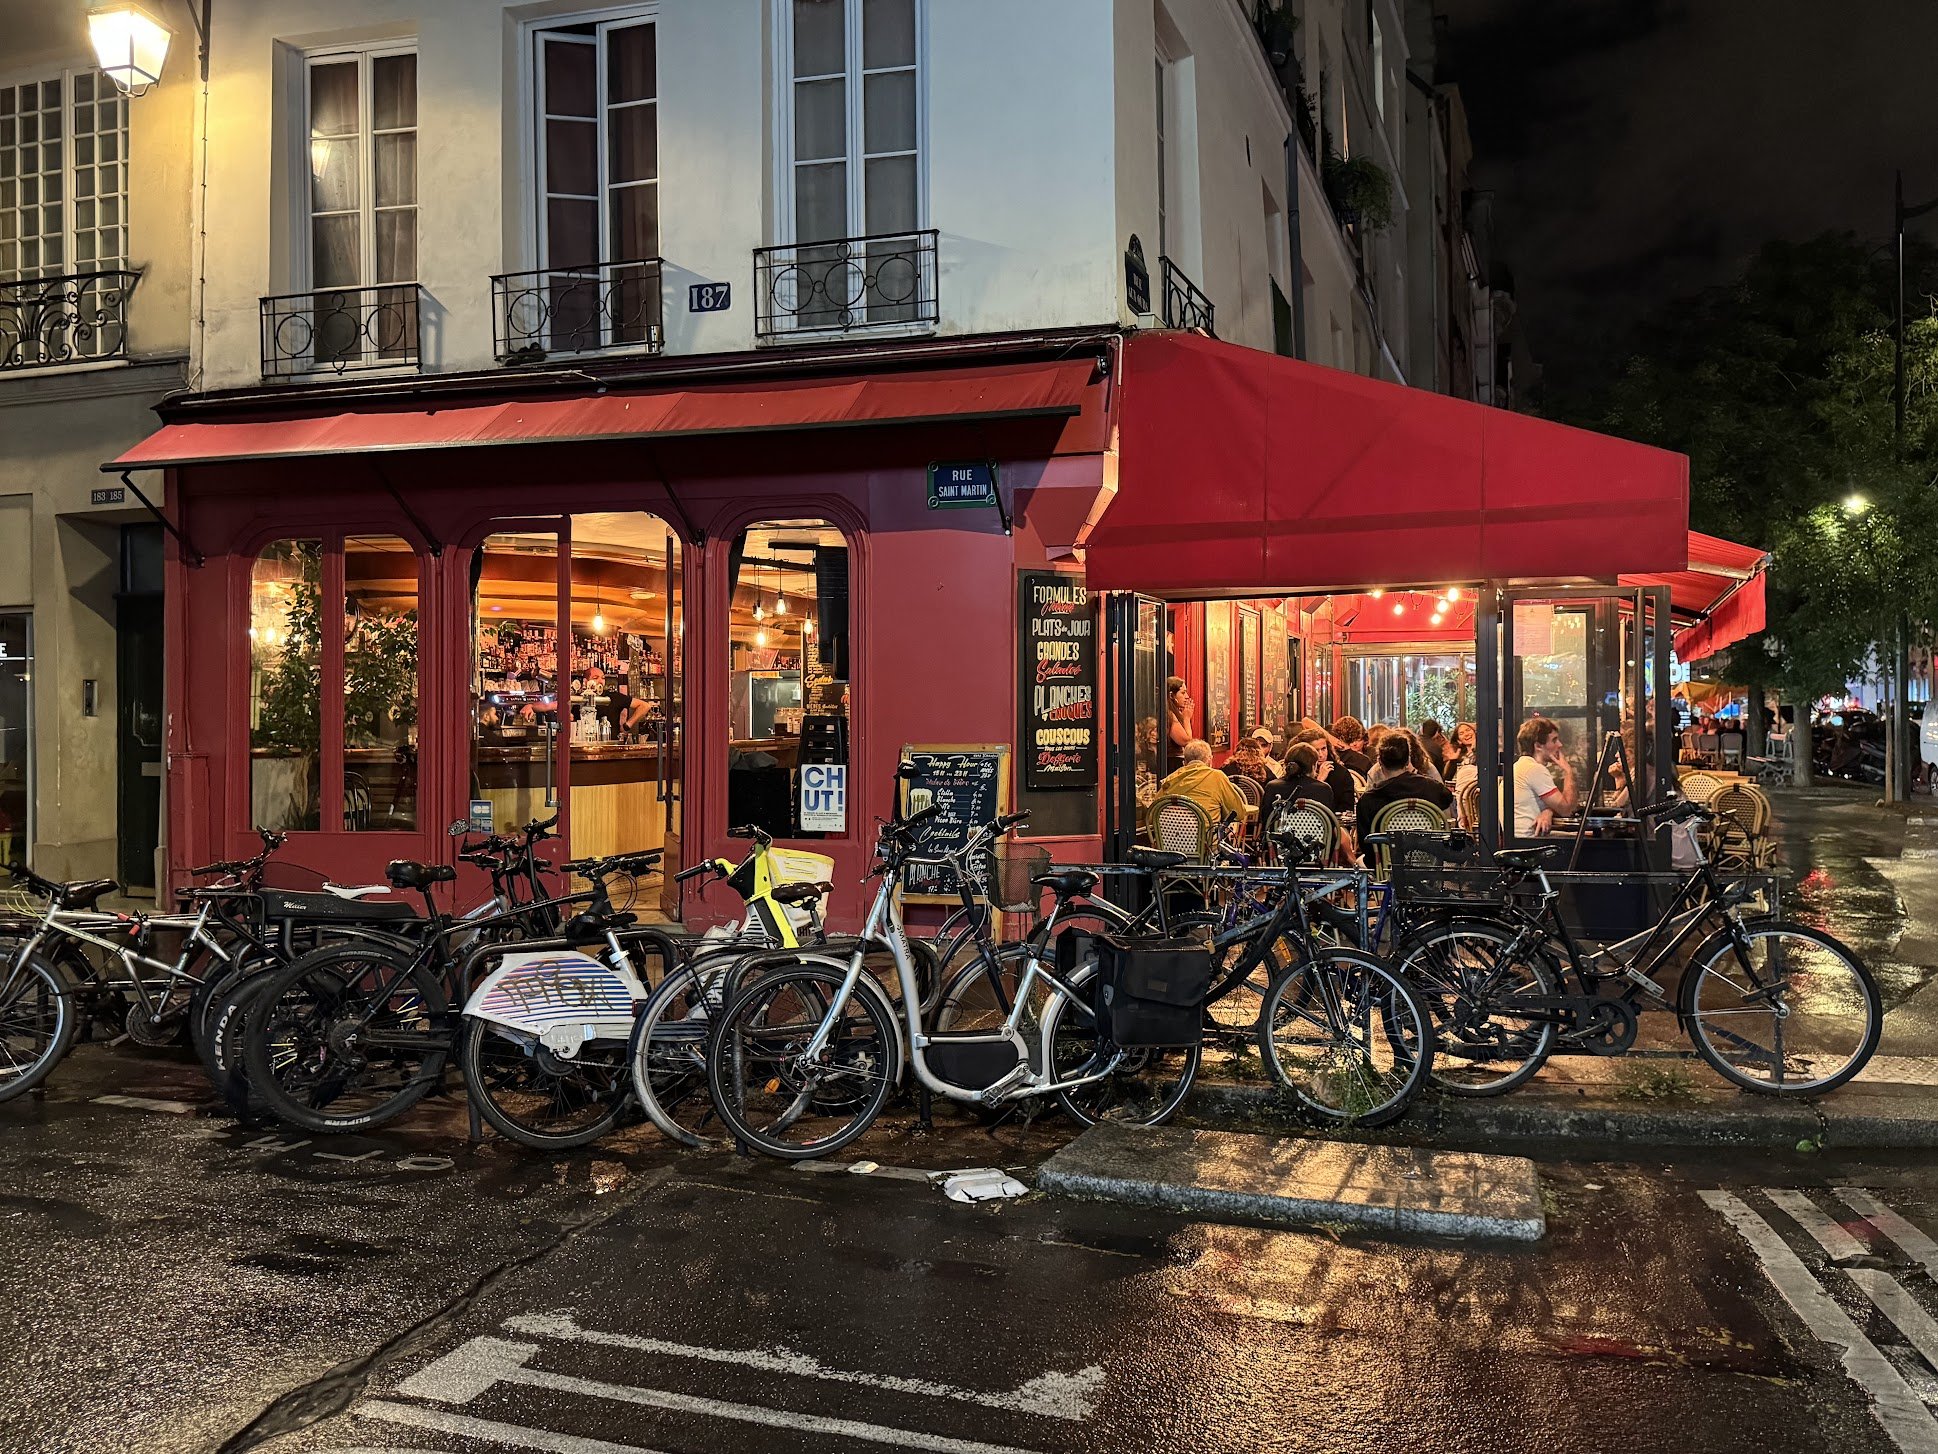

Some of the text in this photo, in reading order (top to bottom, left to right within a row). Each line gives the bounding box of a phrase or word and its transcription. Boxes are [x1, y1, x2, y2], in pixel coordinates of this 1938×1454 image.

[691, 286, 728, 309] 187
[952, 470, 973, 481] RUE
[93, 490, 122, 502] 183 185
[938, 484, 987, 497] SAINT MARTIN
[1033, 586, 1087, 605] FORMULES
[1032, 618, 1061, 636] PLATS
[1067, 620, 1090, 637] JOUR
[1037, 641, 1080, 661] GRANDES
[1036, 660, 1082, 682] Salades
[1034, 685, 1092, 716] PLANCHES
[1049, 702, 1092, 721] CROQUES
[1036, 728, 1090, 746] COUSCOUS
[913, 755, 978, 769] Happy Hour
[805, 767, 843, 788] CH
[805, 790, 843, 811] UT!
[909, 864, 940, 886] PLANCHE
[899, 930, 911, 960] MATRA
[215, 1005, 238, 1070] KENDA
